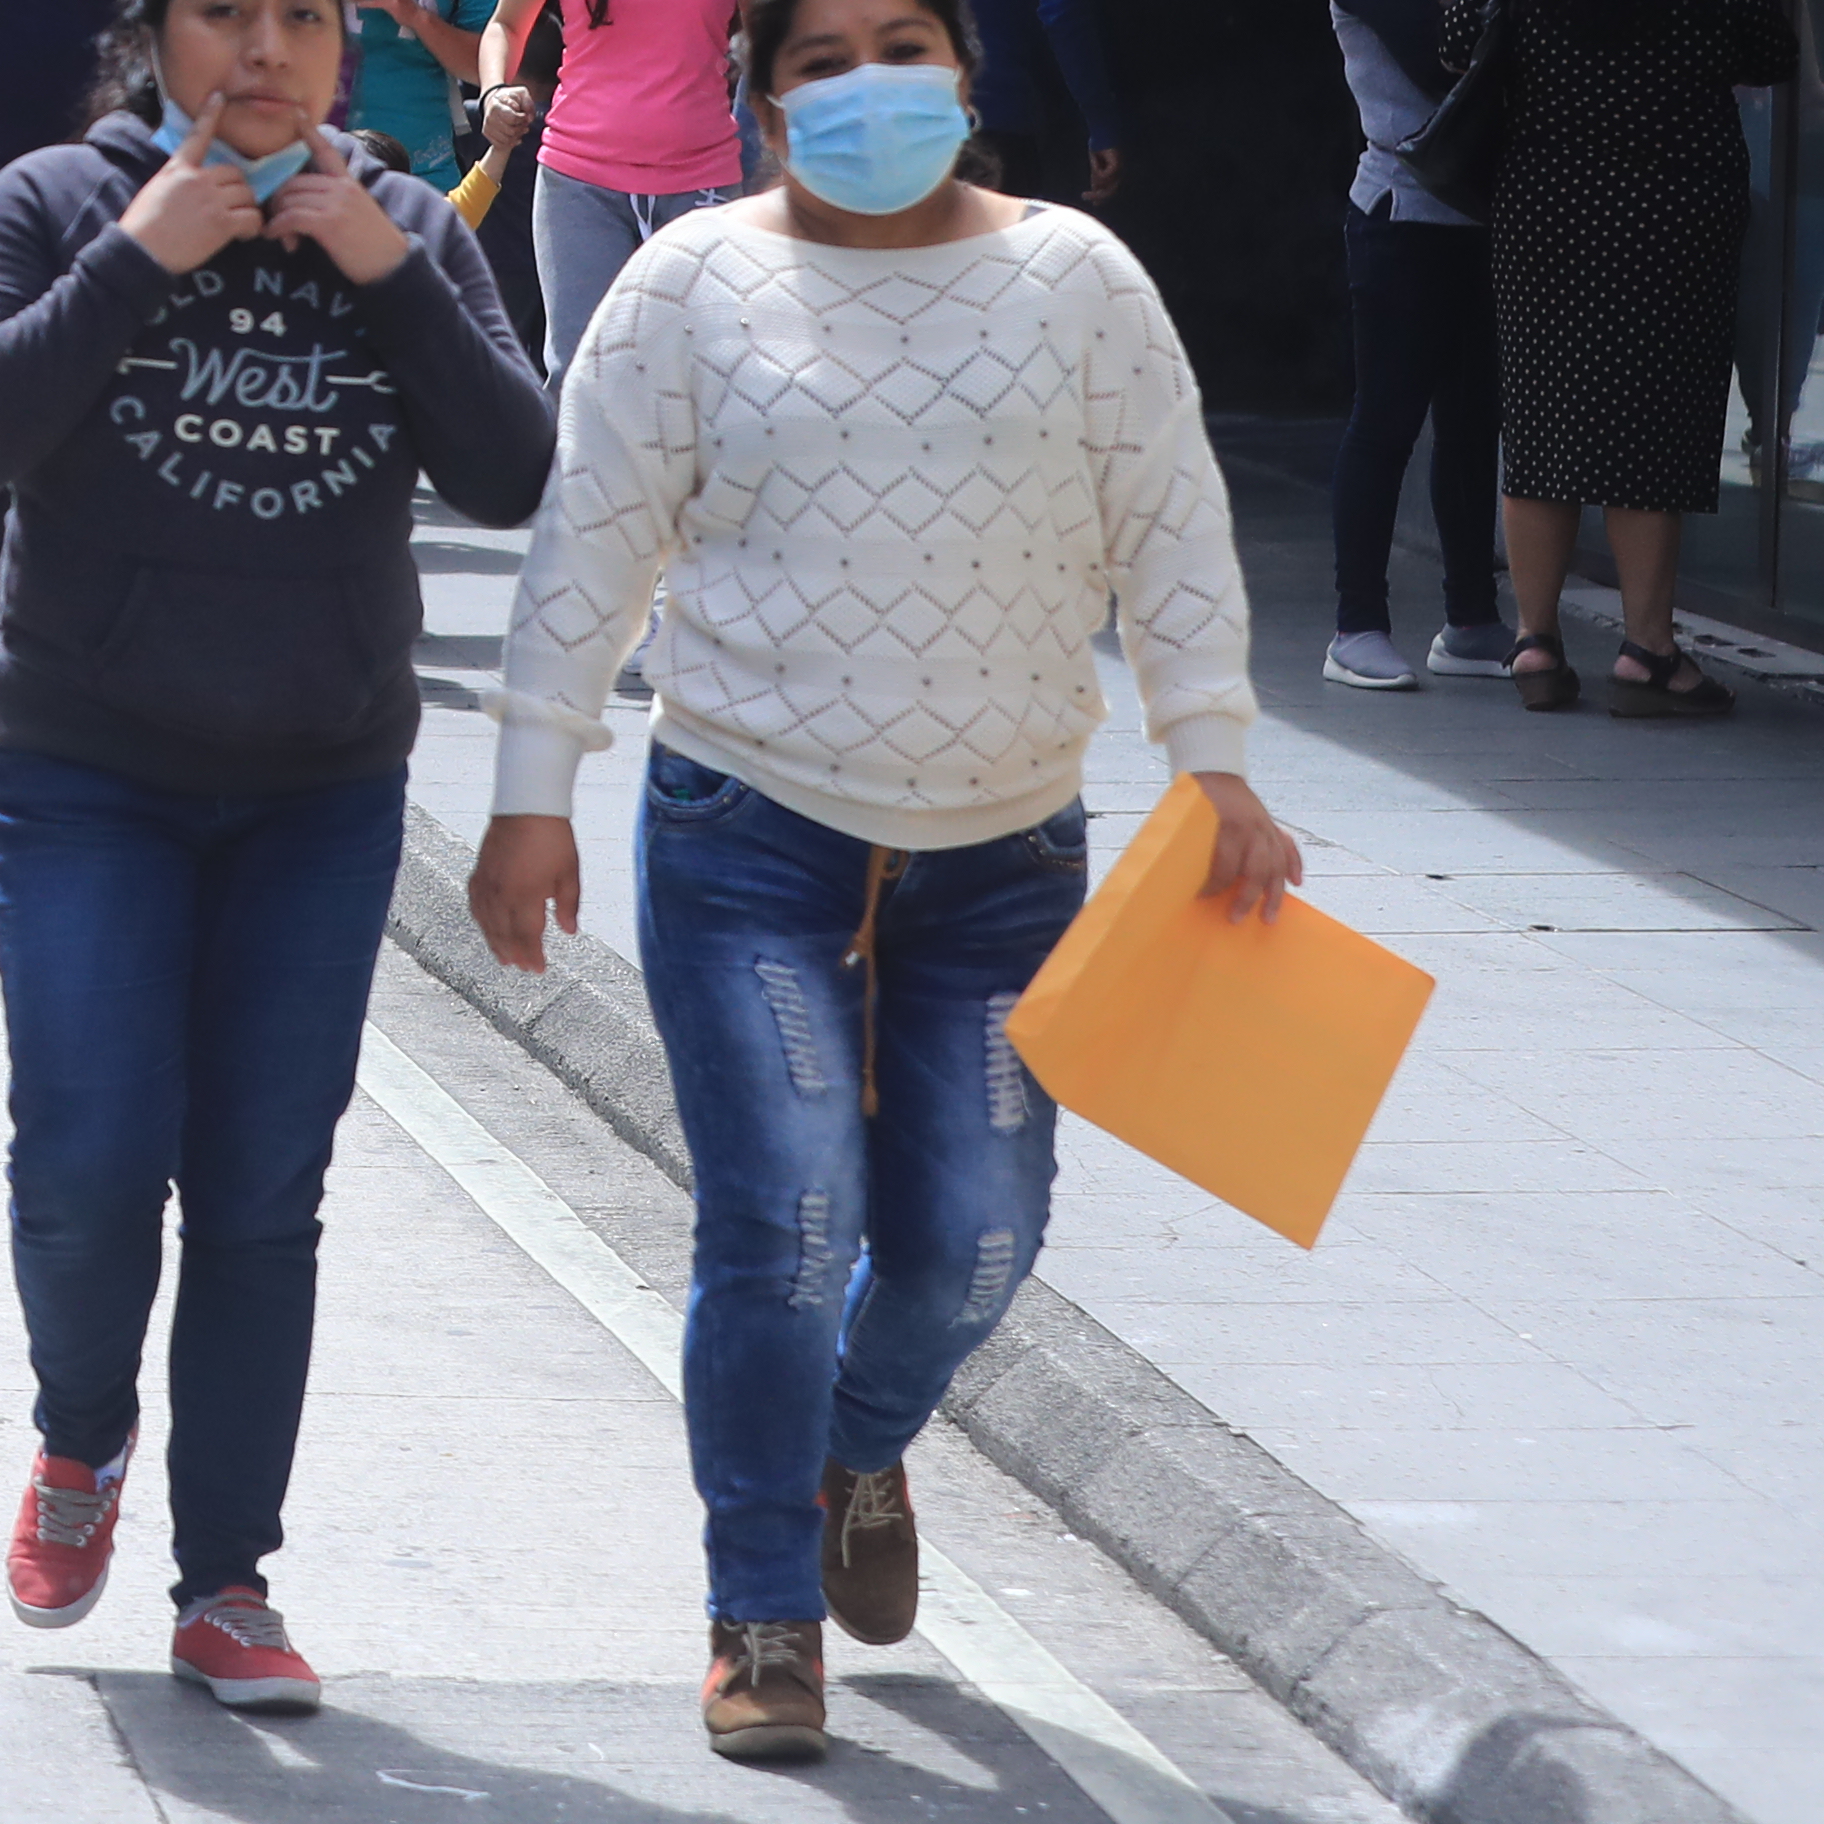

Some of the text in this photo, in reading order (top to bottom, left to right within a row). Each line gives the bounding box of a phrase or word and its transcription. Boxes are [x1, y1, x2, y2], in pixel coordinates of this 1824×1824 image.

[228, 307, 288, 338] 94
[253, 266, 367, 338] NAV
[168, 336, 349, 413] West
[109, 395, 398, 520] CALIFORNIA
[174, 412, 341, 456] COAST
